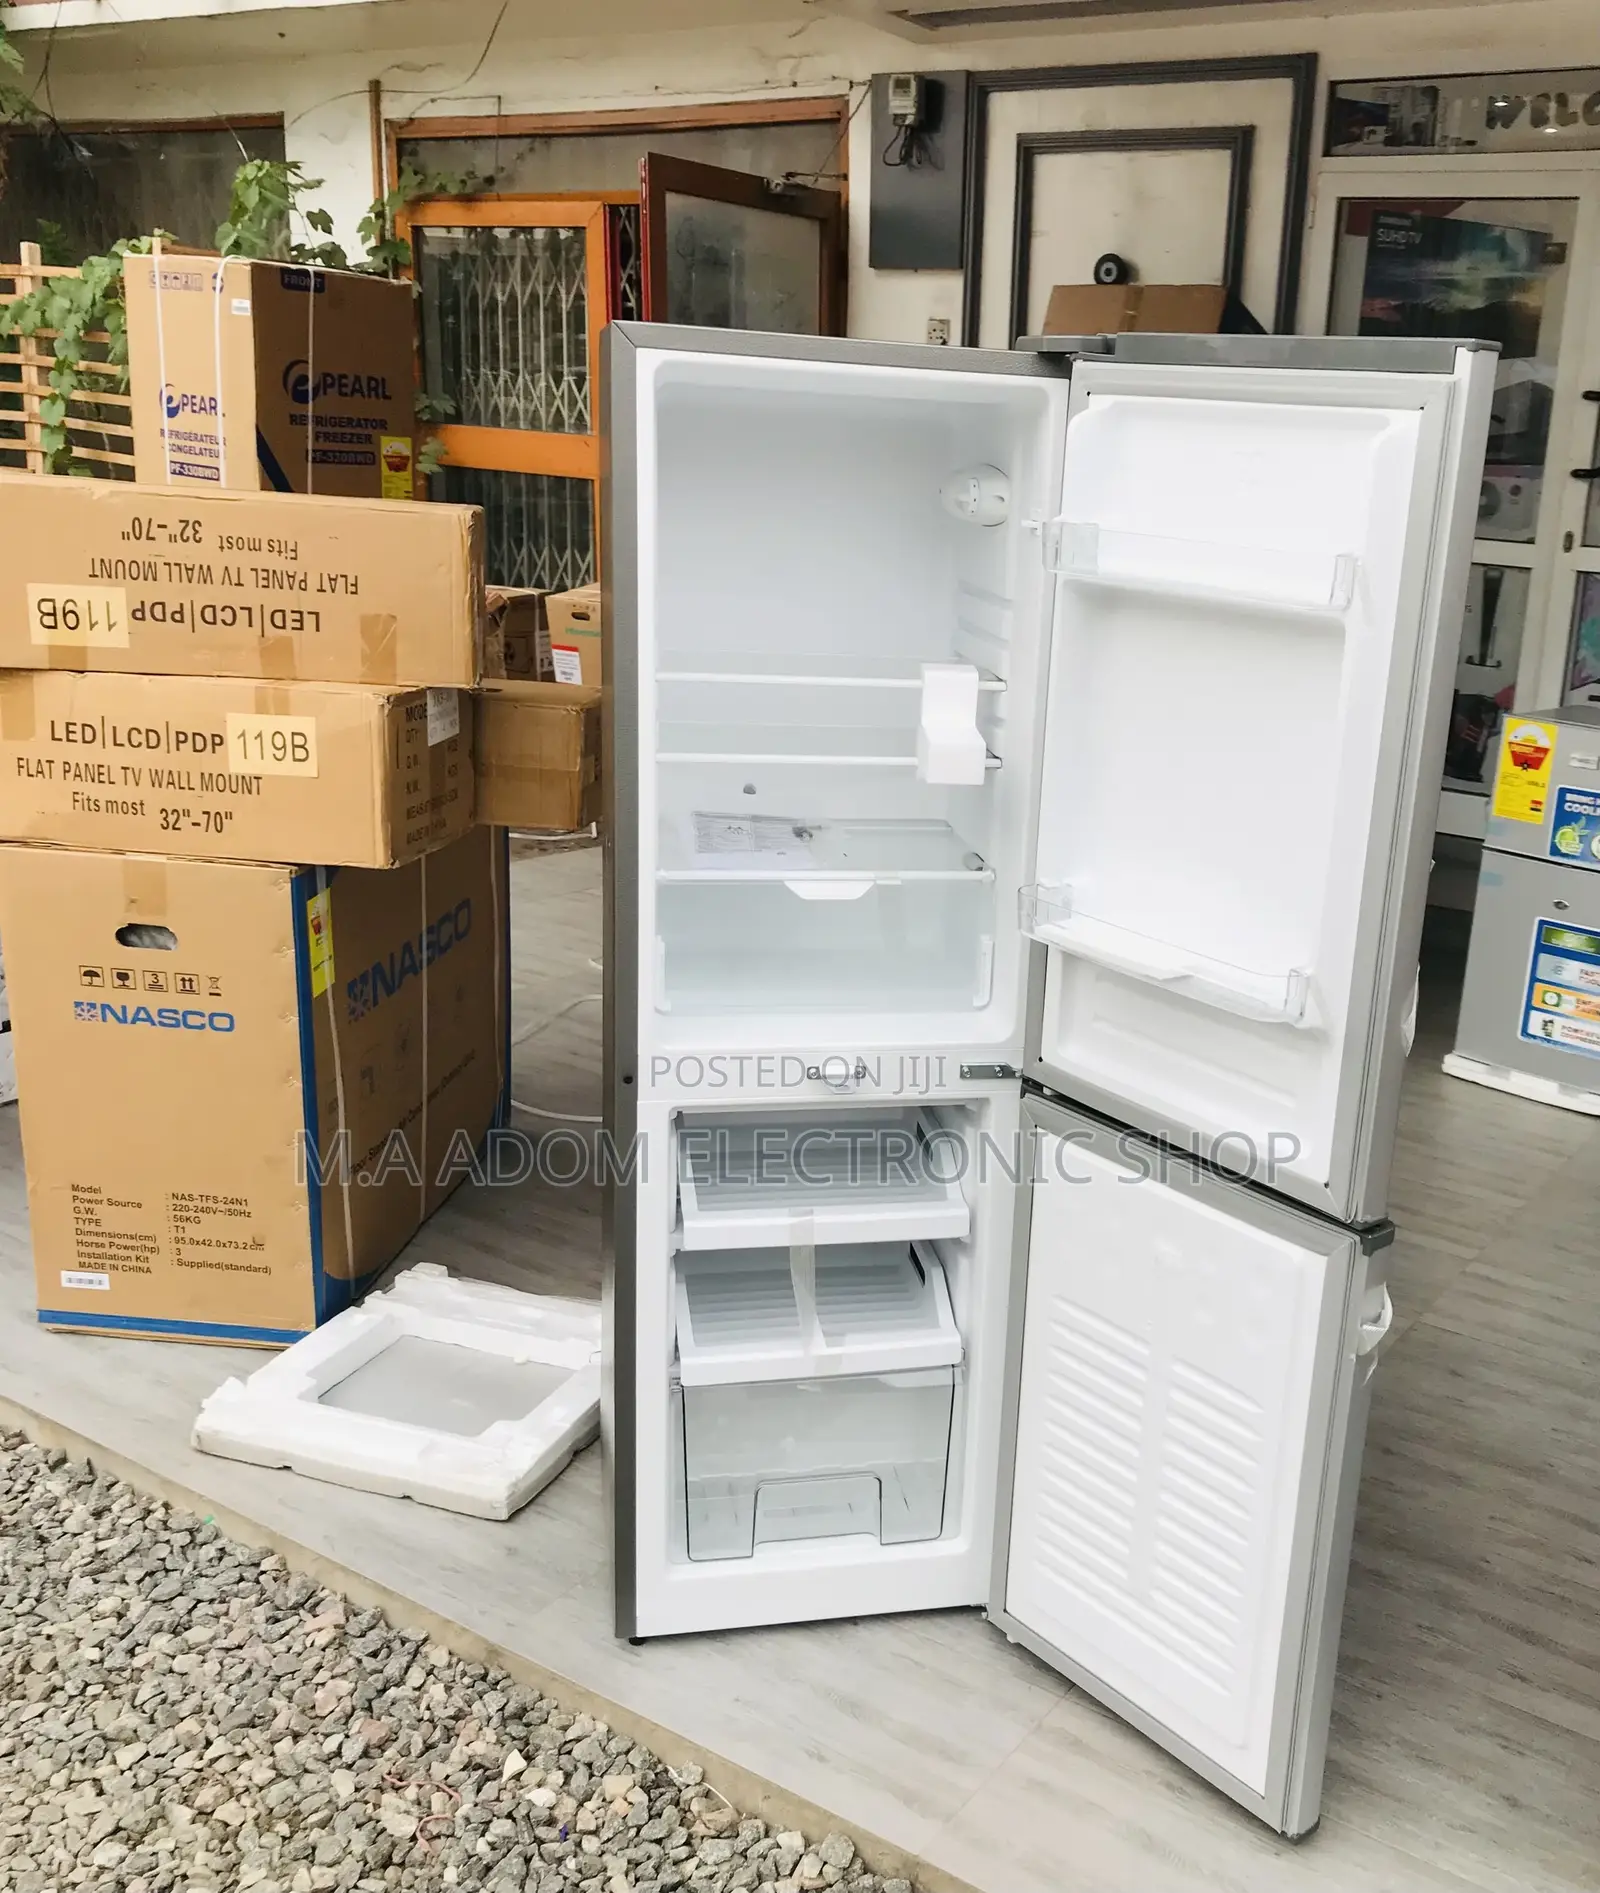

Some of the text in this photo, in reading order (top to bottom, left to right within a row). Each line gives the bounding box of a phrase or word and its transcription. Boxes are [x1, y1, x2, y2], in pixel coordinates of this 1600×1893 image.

[321, 372, 392, 400] PEARL
[315, 431, 374, 444] FREEZER
[218, 535, 298, 561] Fits most
[88, 558, 359, 595] FLAT PANEL TV WALL MOUNT
[37, 597, 117, 632] 119B
[237, 729, 310, 763] 119B
[16, 757, 263, 795] FLAT PANEL TV WALL MOUNT
[72, 791, 146, 816] Fits most
[372, 898, 472, 1009] NASCO
[100, 1003, 235, 1032] NASCO
[71, 1184, 101, 1194] Model
[72, 1195, 142, 1209] Power Source
[171, 1192, 249, 1207] NAS-TFS-24N1
[73, 1206, 97, 1216] G.W.
[74, 1217, 102, 1227] TYPE
[173, 1214, 201, 1225] 56KG
[75, 1227, 157, 1244] Dimensions(cm)
[174, 1225, 186, 1234] T1
[76, 1239, 160, 1255] Horse Power(hp)
[77, 1250, 149, 1264] Installation Kit
[78, 1261, 152, 1274] MADE IN CHINA
[176, 1259, 272, 1275] Supplied(standard)
